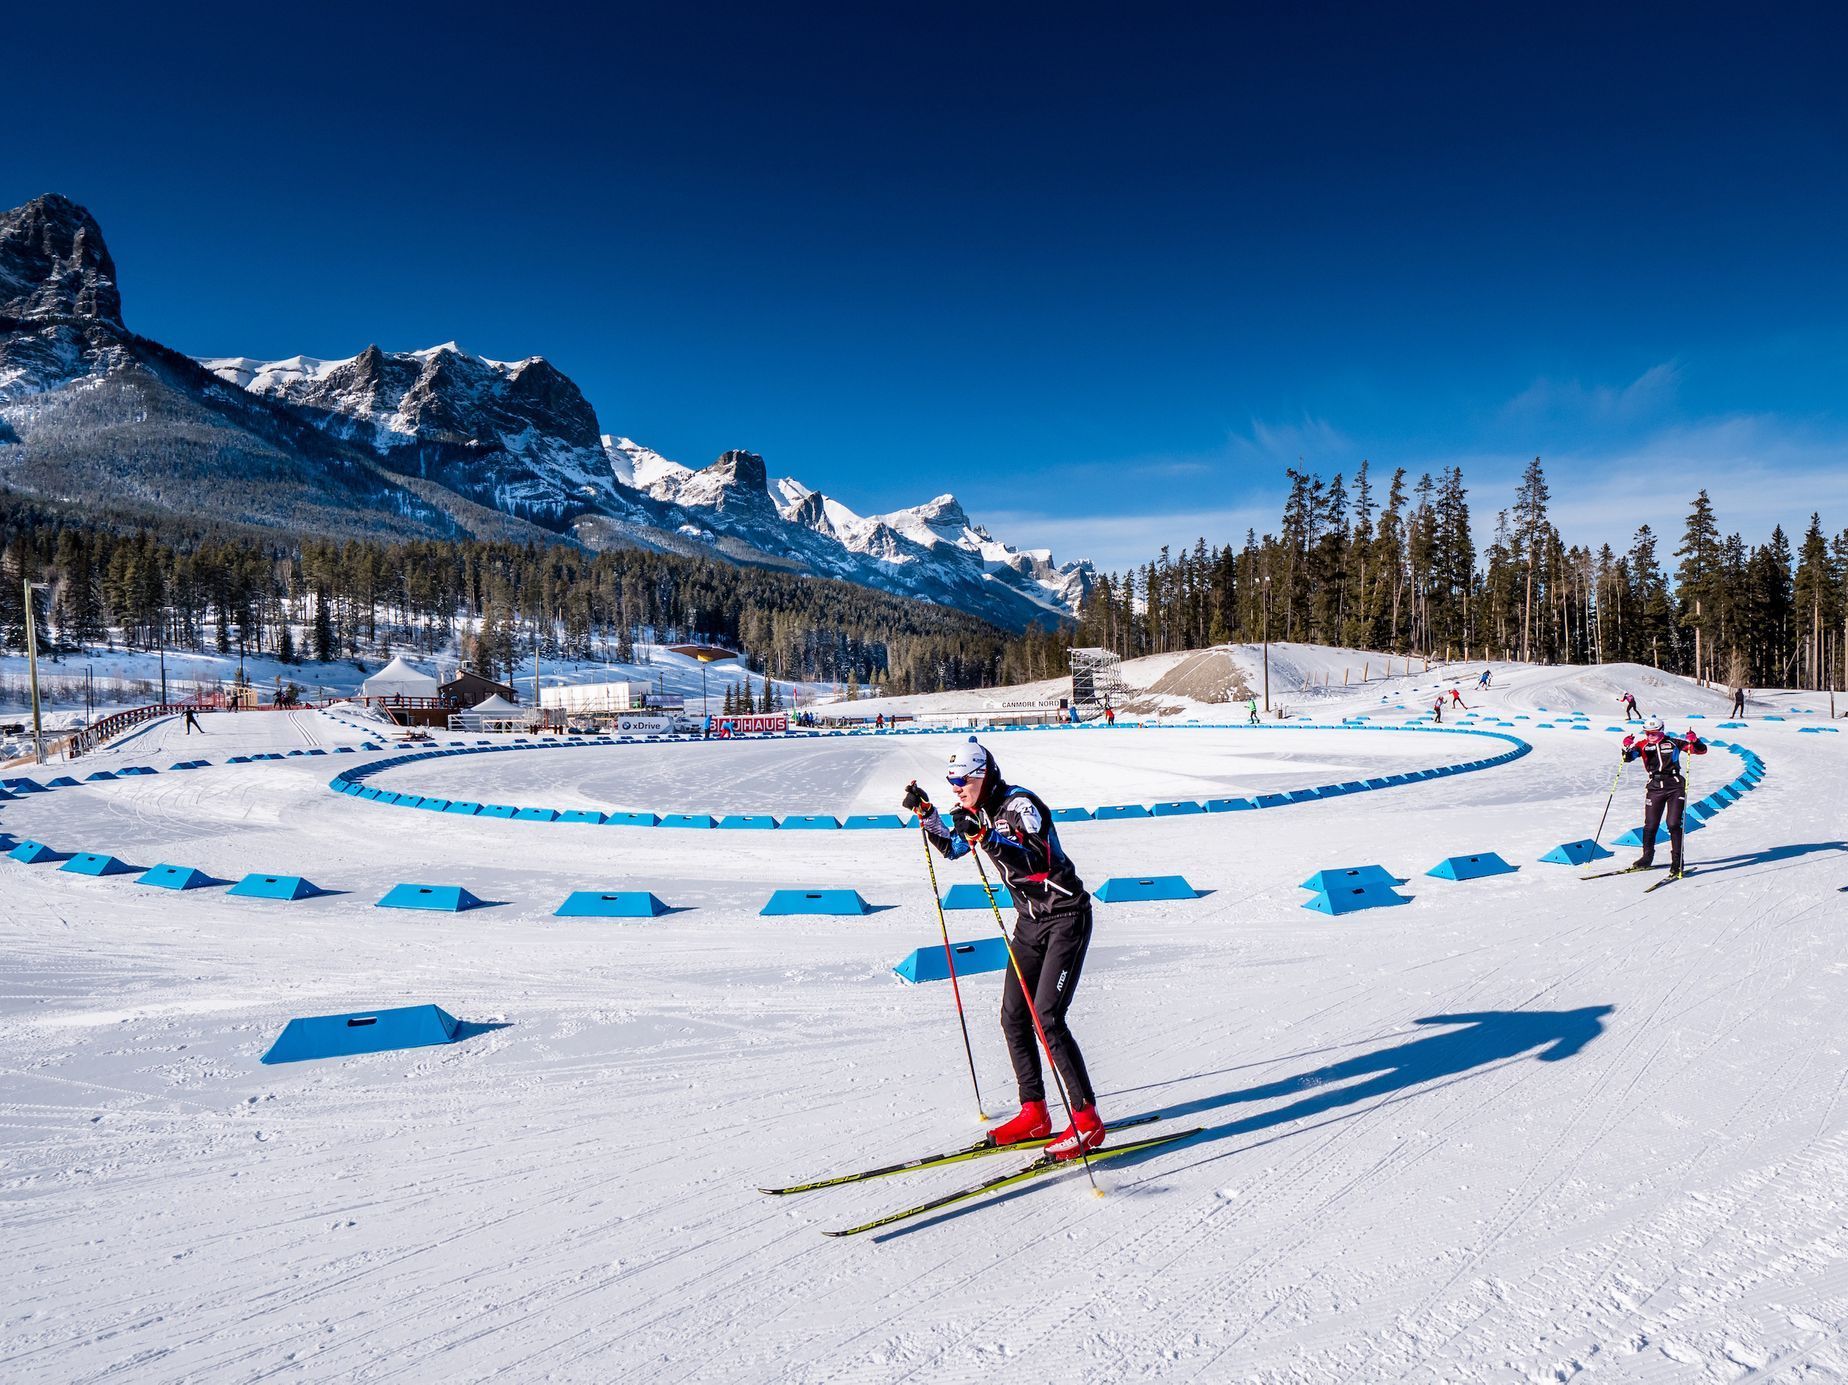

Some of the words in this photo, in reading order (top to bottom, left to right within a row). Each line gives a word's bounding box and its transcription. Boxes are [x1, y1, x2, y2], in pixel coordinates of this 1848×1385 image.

[633, 722, 661, 730] xDrive
[971, 1144, 1018, 1158] FISCHER
[1034, 1158, 1077, 1176] FISCHER
